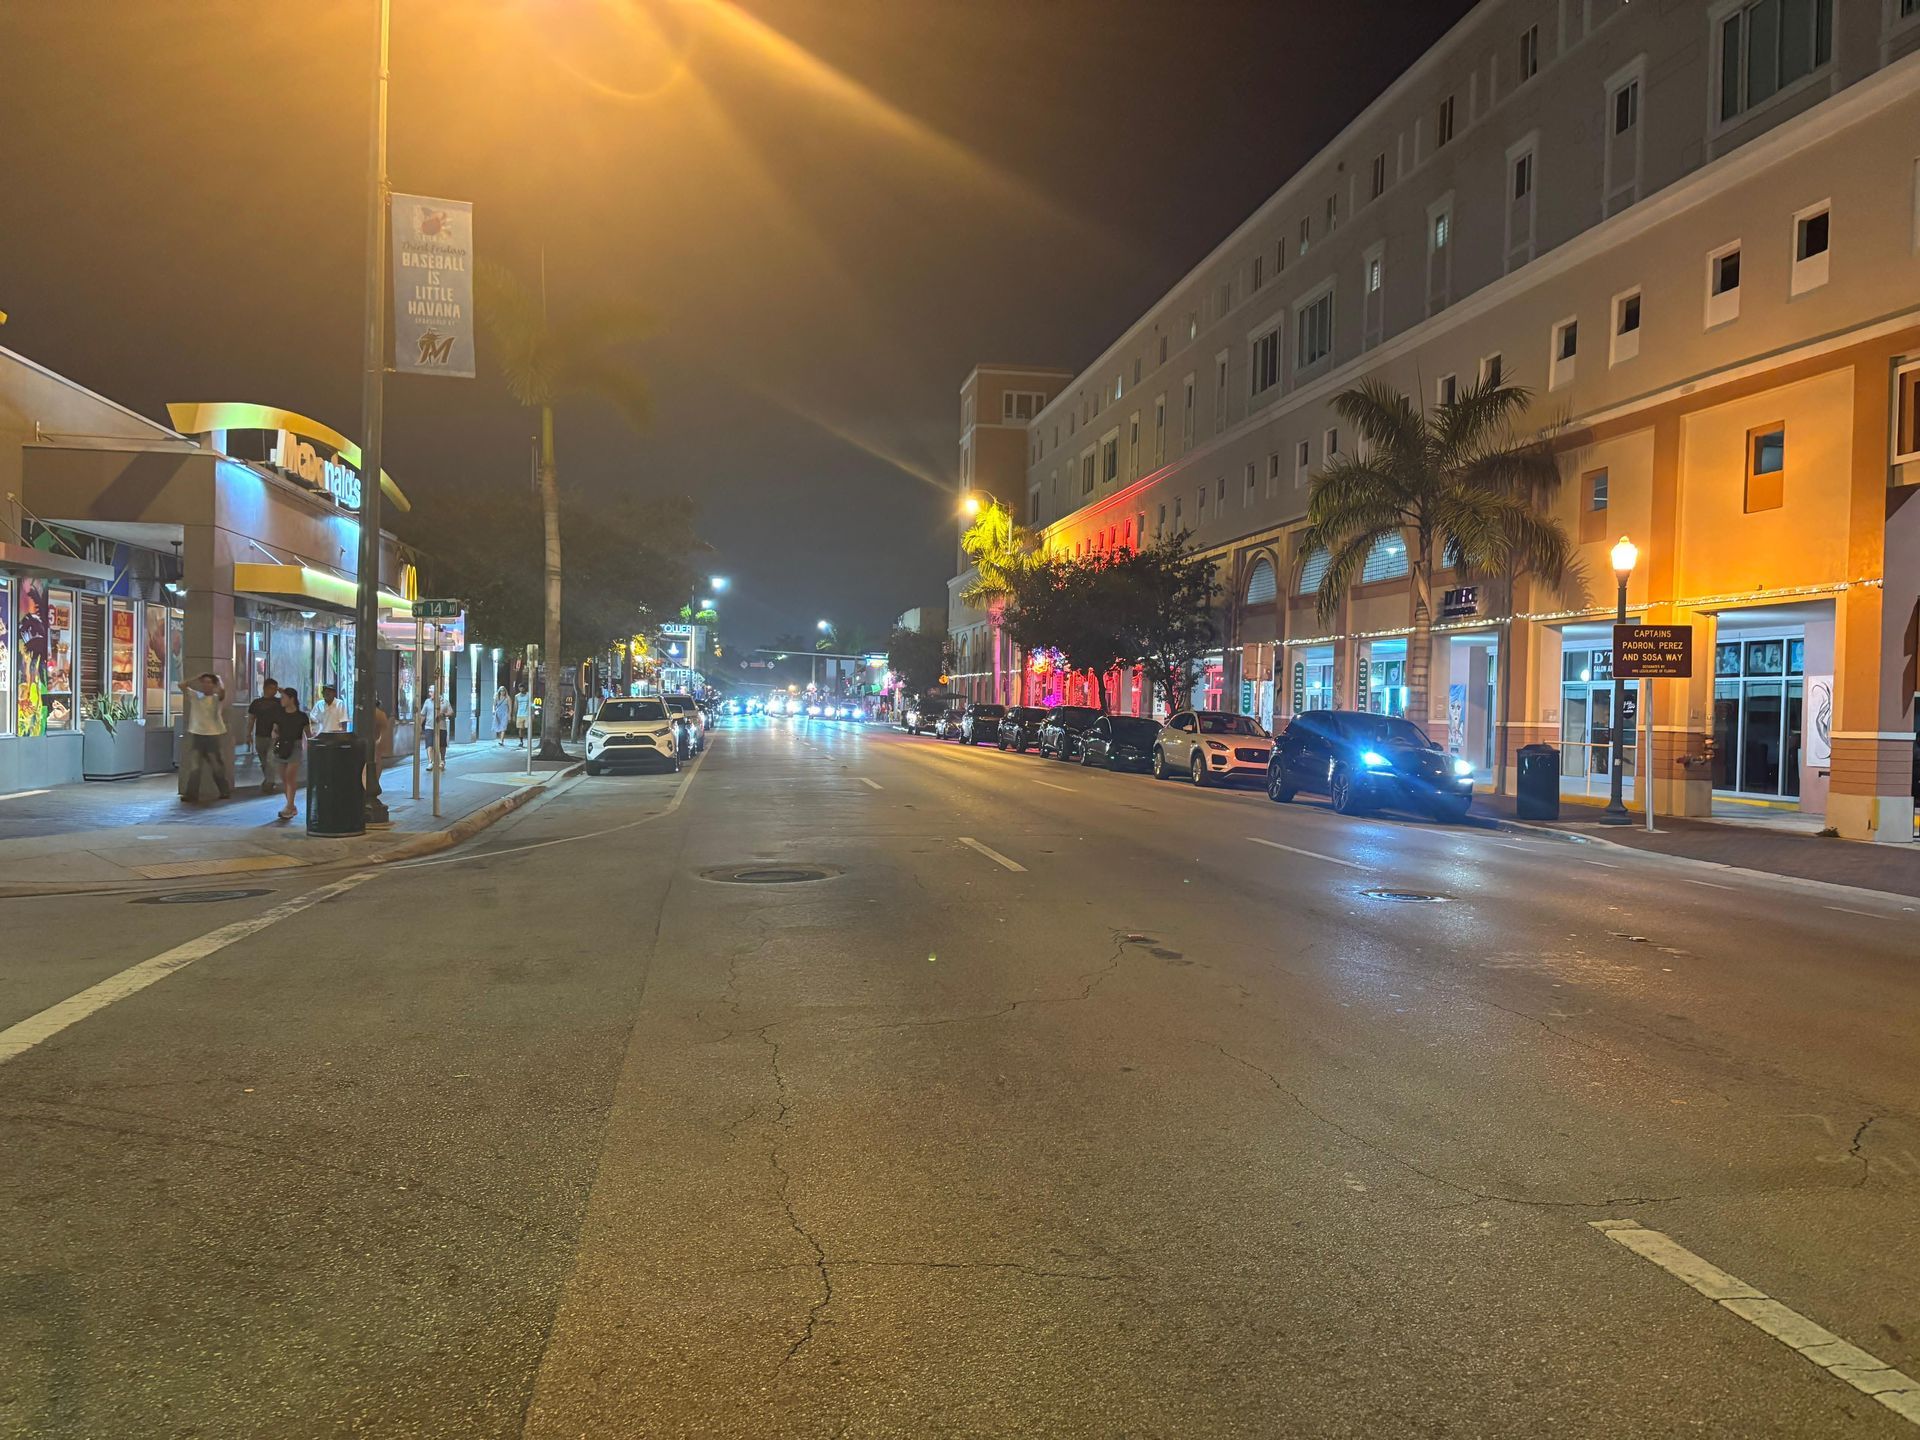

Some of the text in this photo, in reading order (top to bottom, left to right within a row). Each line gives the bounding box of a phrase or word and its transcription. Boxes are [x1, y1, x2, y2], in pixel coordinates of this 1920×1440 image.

[402, 252, 465, 271] BASEBALL
[428, 271, 440, 285] IS
[415, 286, 453, 302] LITTLE
[408, 301, 460, 320] HAVANA
[276, 429, 361, 508] McDonald's
[413, 605, 423, 615] SW
[430, 602, 442, 615] 14
[1634, 629, 1672, 638] CAPTAINS
[1659, 641, 1683, 650] PEREZ
[1622, 653, 1683, 661] AND SOSA WAY
